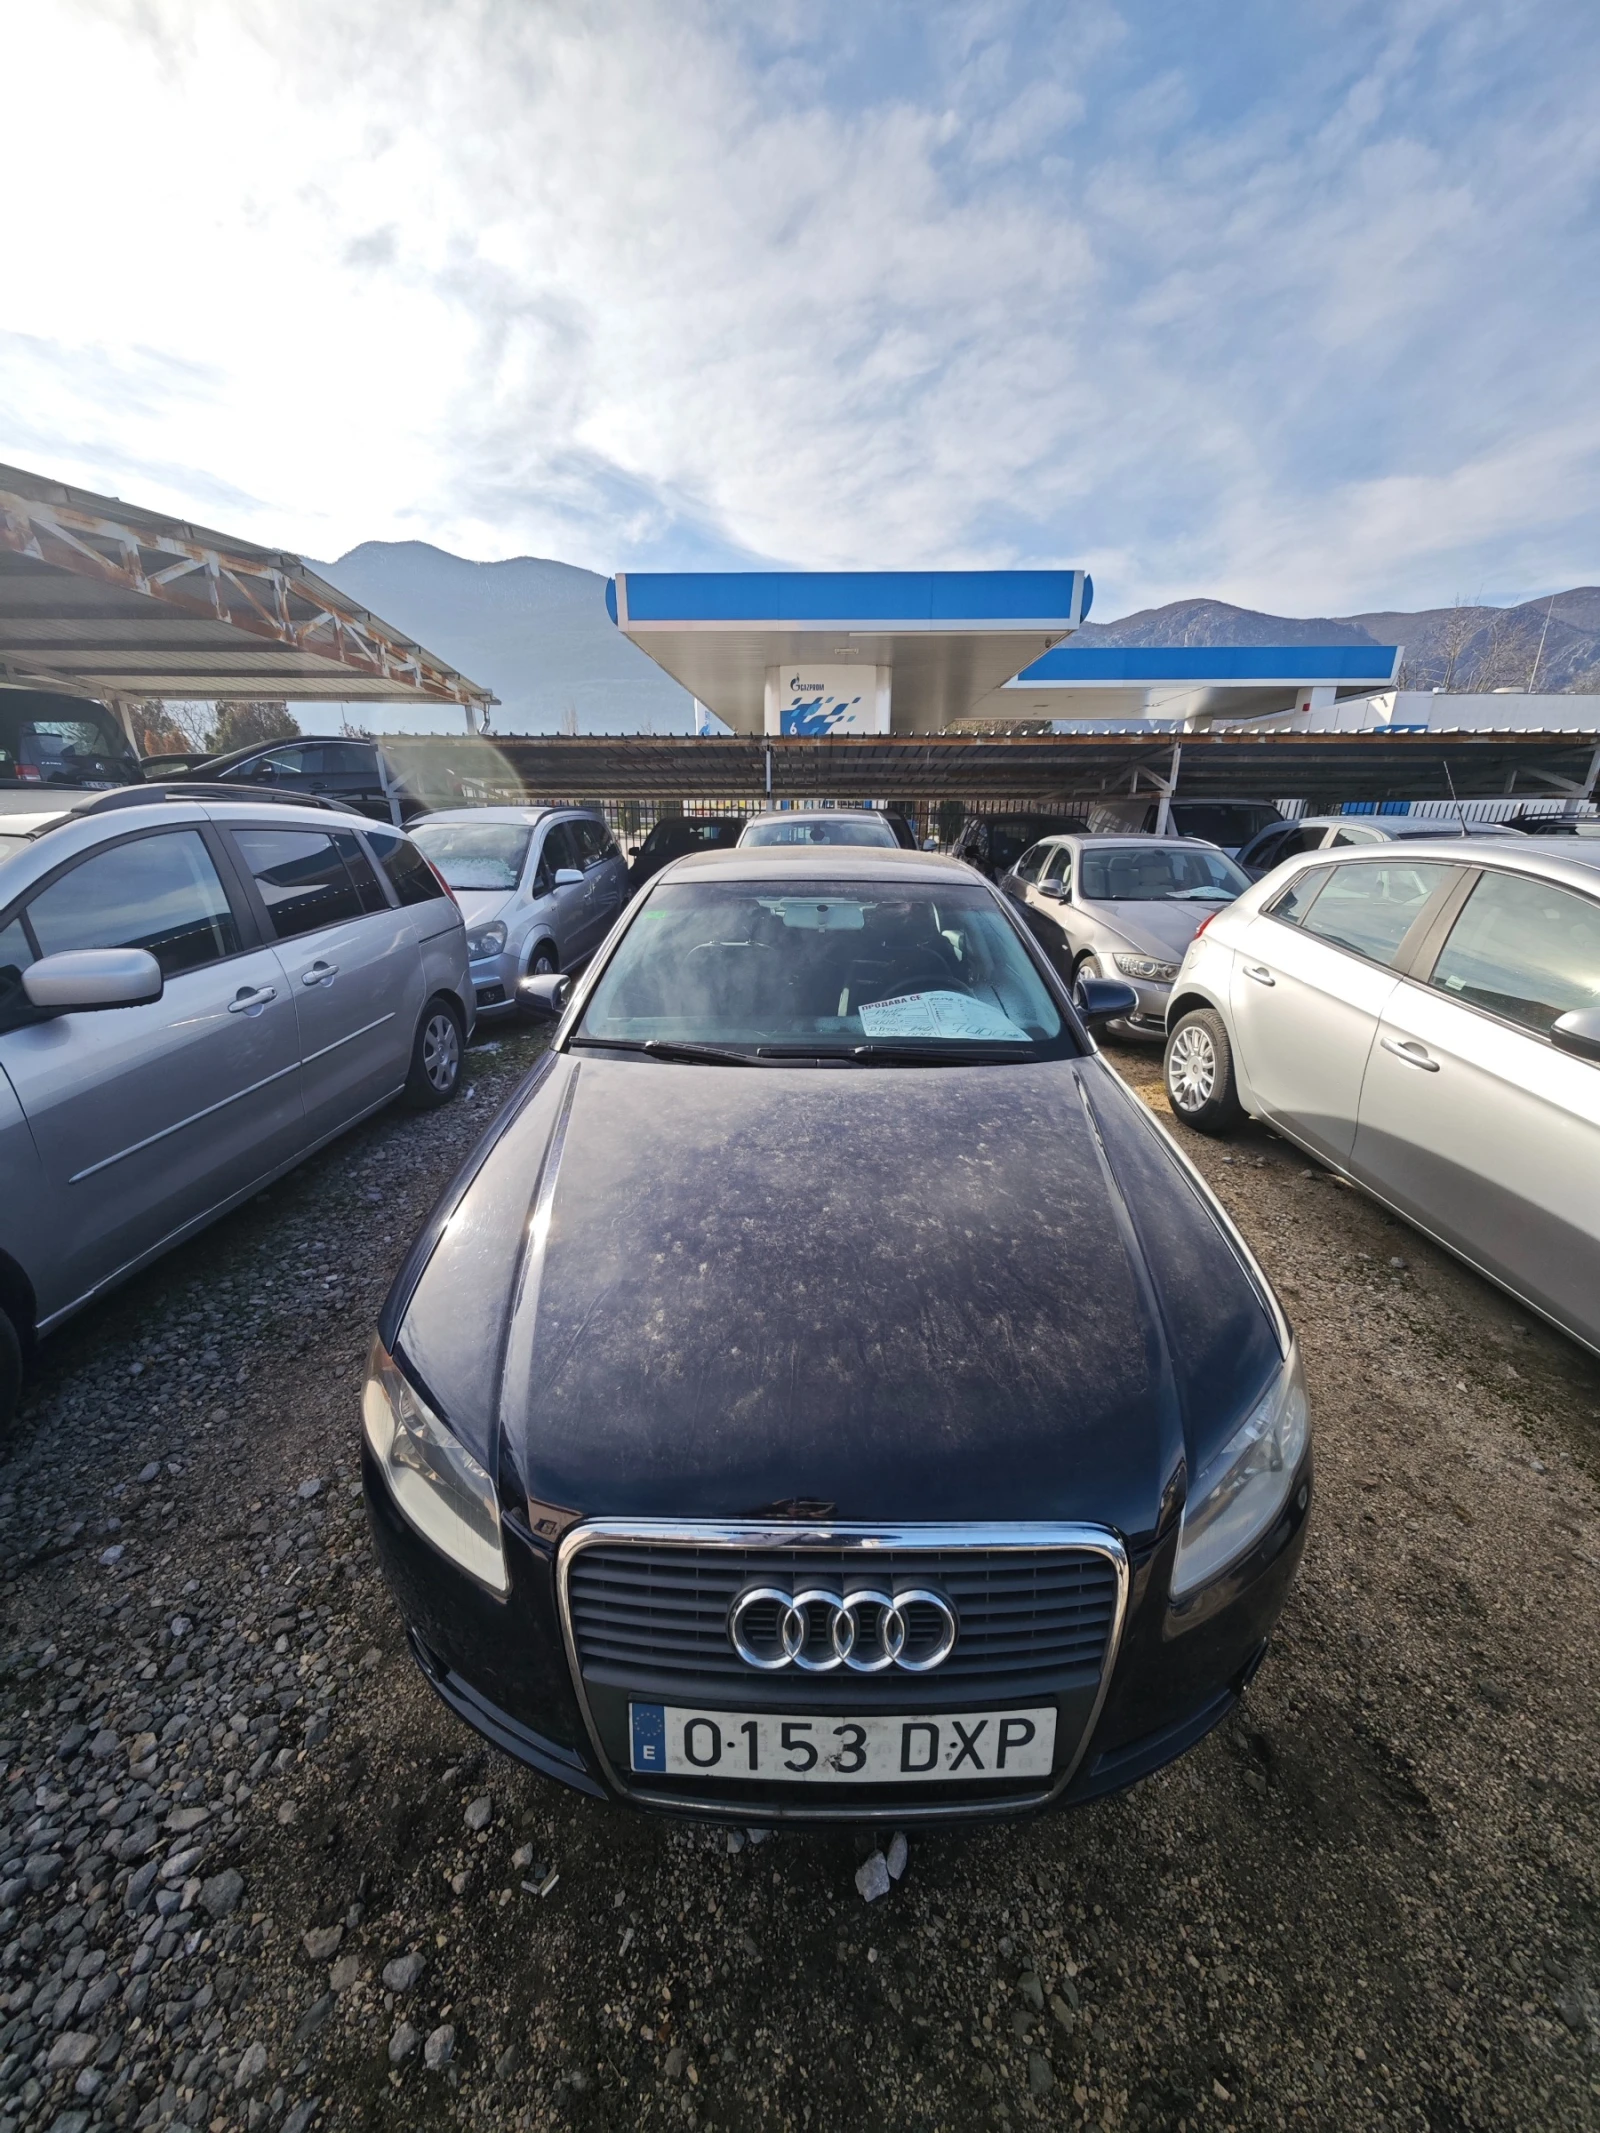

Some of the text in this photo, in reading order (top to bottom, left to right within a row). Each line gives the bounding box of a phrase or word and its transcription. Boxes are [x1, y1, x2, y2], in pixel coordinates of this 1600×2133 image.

[790, 722, 797, 735] 6
[861, 997, 908, 1011] ПРОДАВА
[909, 994, 923, 1003] СЕ
[643, 1745, 655, 1760] E
[683, 1717, 1037, 1774] 0153 DXP
